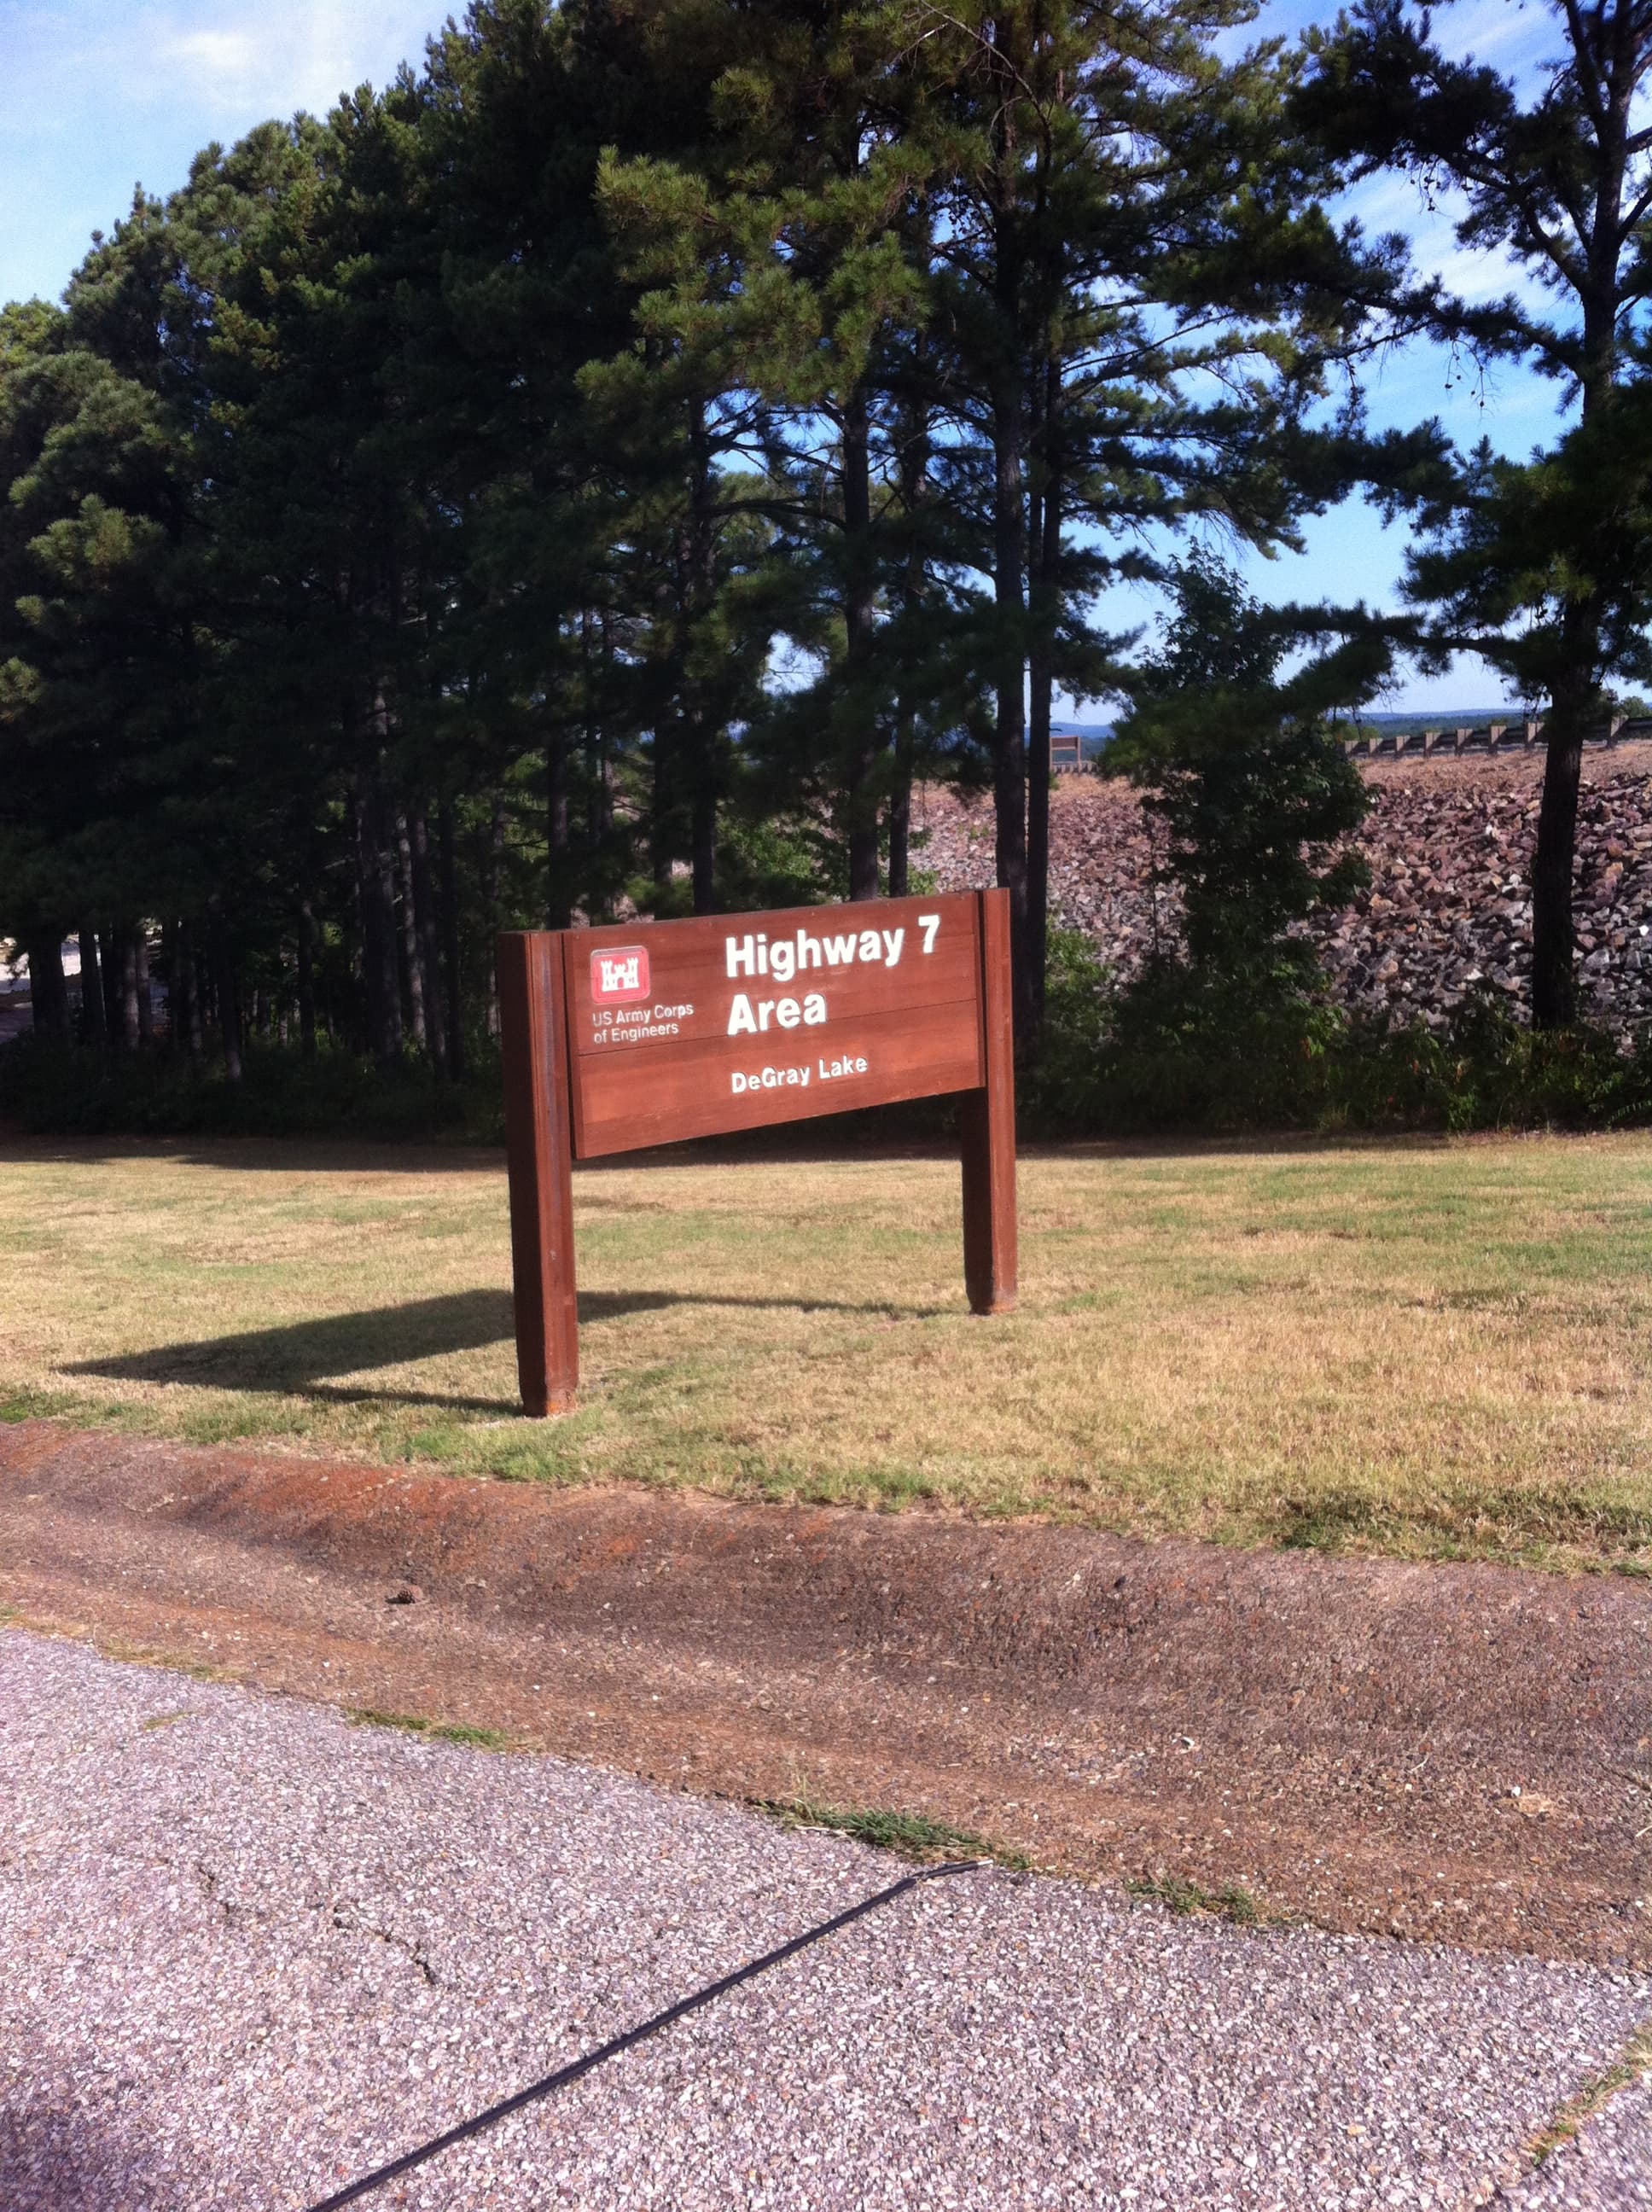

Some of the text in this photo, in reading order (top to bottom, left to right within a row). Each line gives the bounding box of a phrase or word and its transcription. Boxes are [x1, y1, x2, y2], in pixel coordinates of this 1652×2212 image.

[725, 914, 940, 981] Highway 7
[592, 1004, 694, 1027] US Army Corps
[594, 1022, 679, 1044] of Engineers
[727, 992, 827, 1036] Area
[731, 1055, 869, 1093] DeGray Lake
